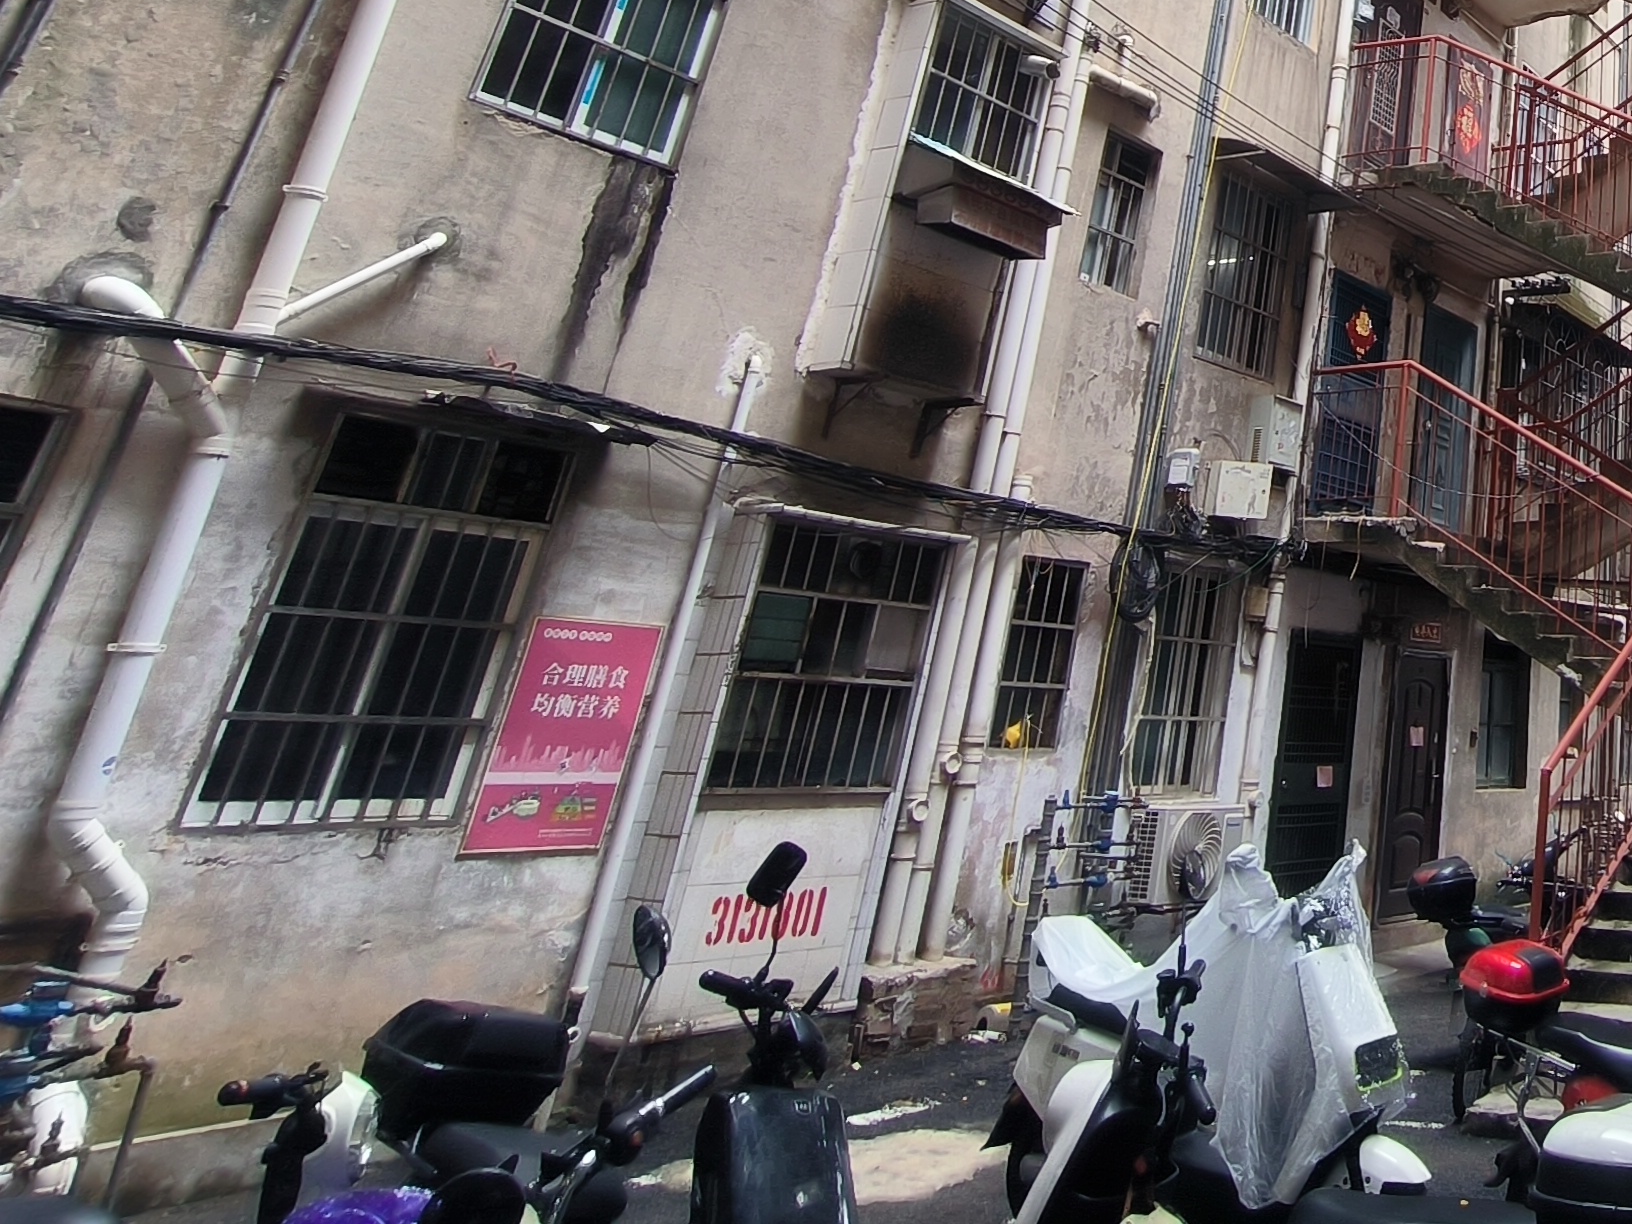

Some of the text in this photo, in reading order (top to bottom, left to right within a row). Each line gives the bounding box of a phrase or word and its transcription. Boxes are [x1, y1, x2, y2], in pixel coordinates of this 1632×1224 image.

[542, 662, 630, 689] 合理膳食
[530, 693, 621, 719] 均衡营养
